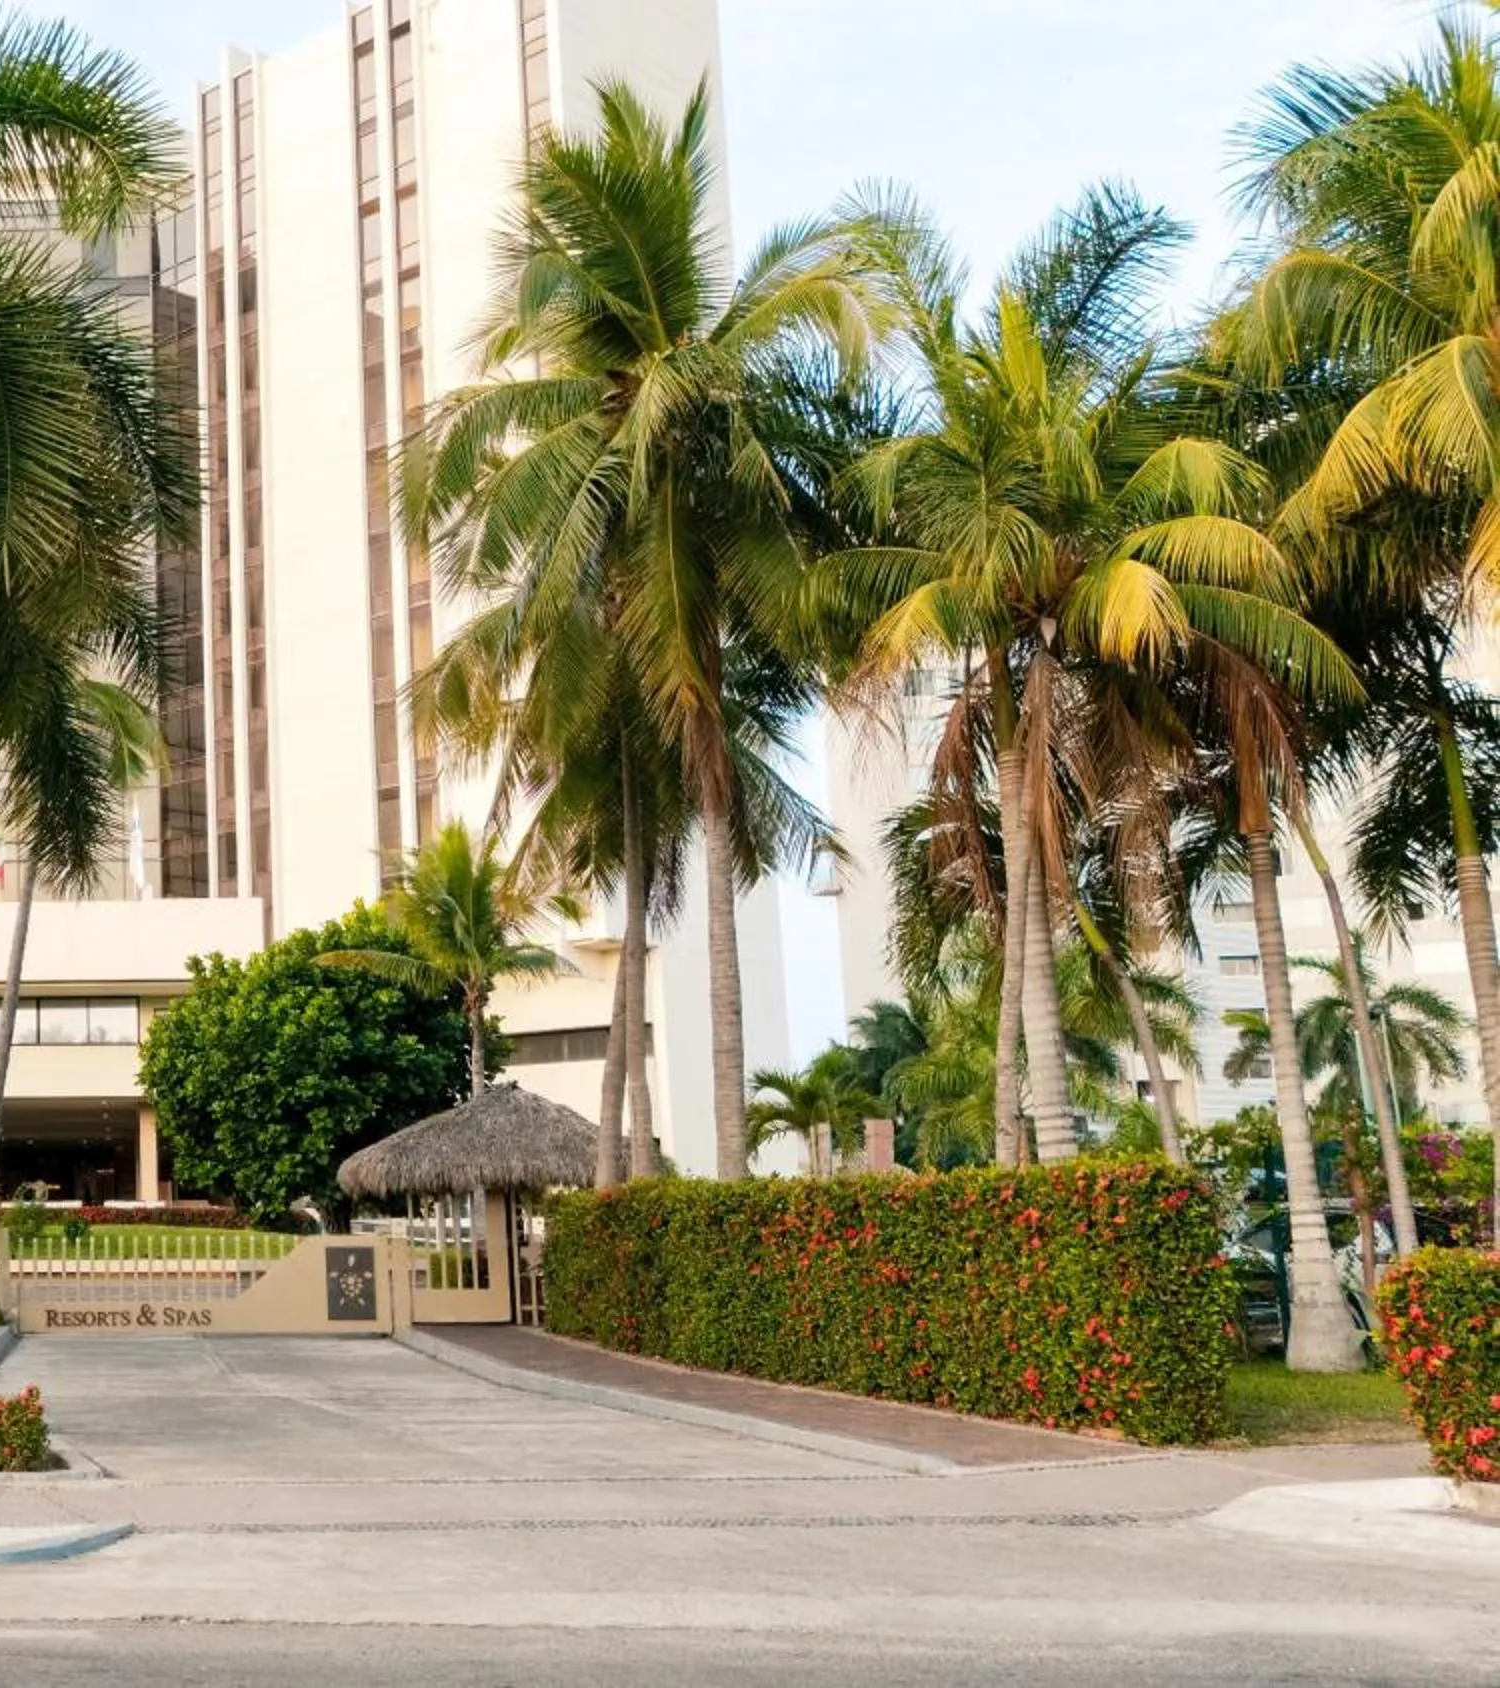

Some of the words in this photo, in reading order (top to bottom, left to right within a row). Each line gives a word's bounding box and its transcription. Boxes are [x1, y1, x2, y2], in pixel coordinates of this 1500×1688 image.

[45, 1309, 131, 1328] RESORTS
[136, 1303, 157, 1327] &
[163, 1307, 213, 1327] SPAS
